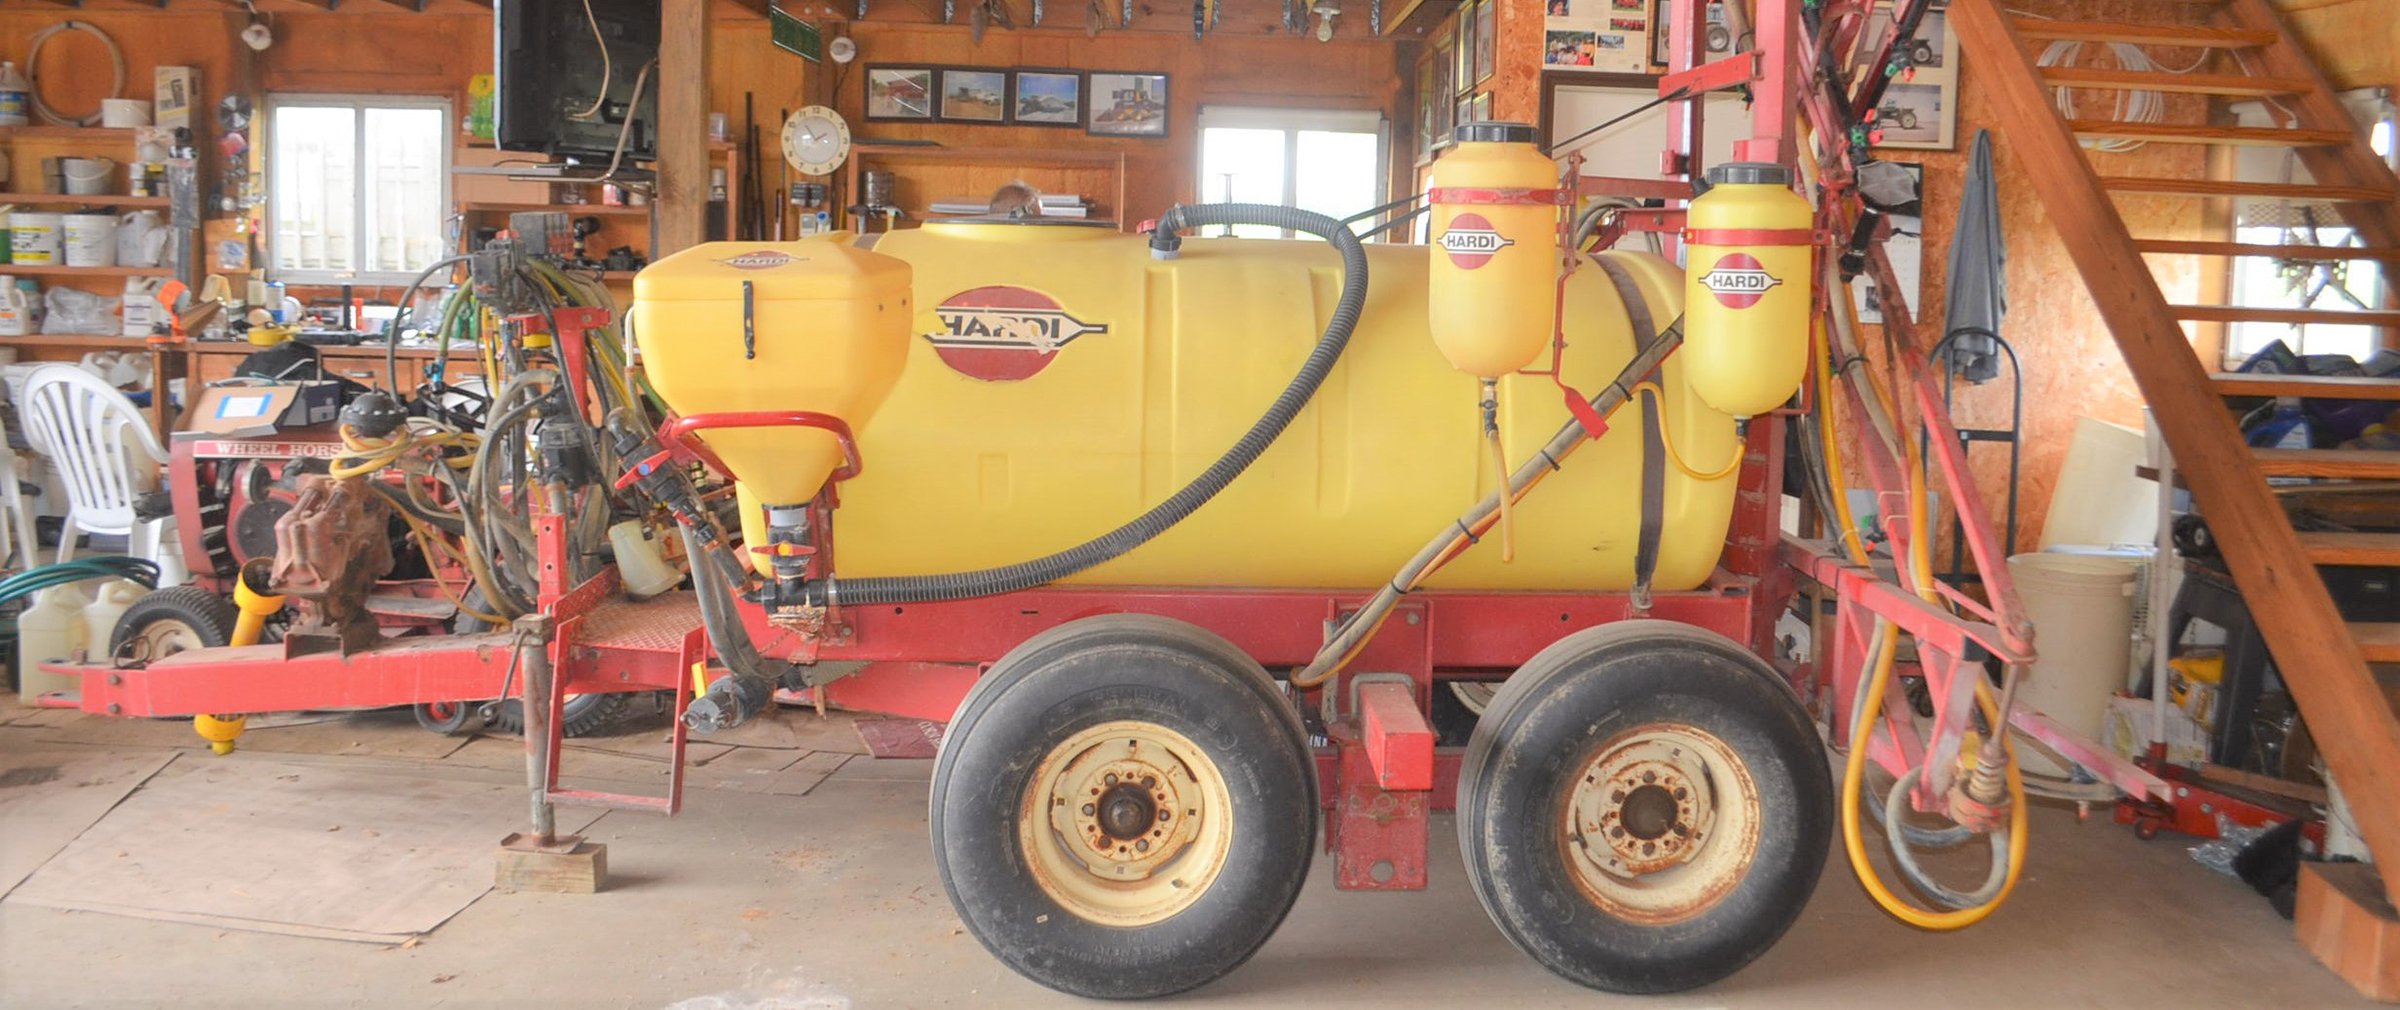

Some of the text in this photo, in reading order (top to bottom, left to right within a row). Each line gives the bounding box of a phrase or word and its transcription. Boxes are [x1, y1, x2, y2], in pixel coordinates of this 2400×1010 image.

[1447, 234, 1496, 249] HARDI
[733, 256, 790, 265] HARDI
[1712, 274, 1765, 288] HARDI
[215, 442, 344, 457] WHEEL HORS
